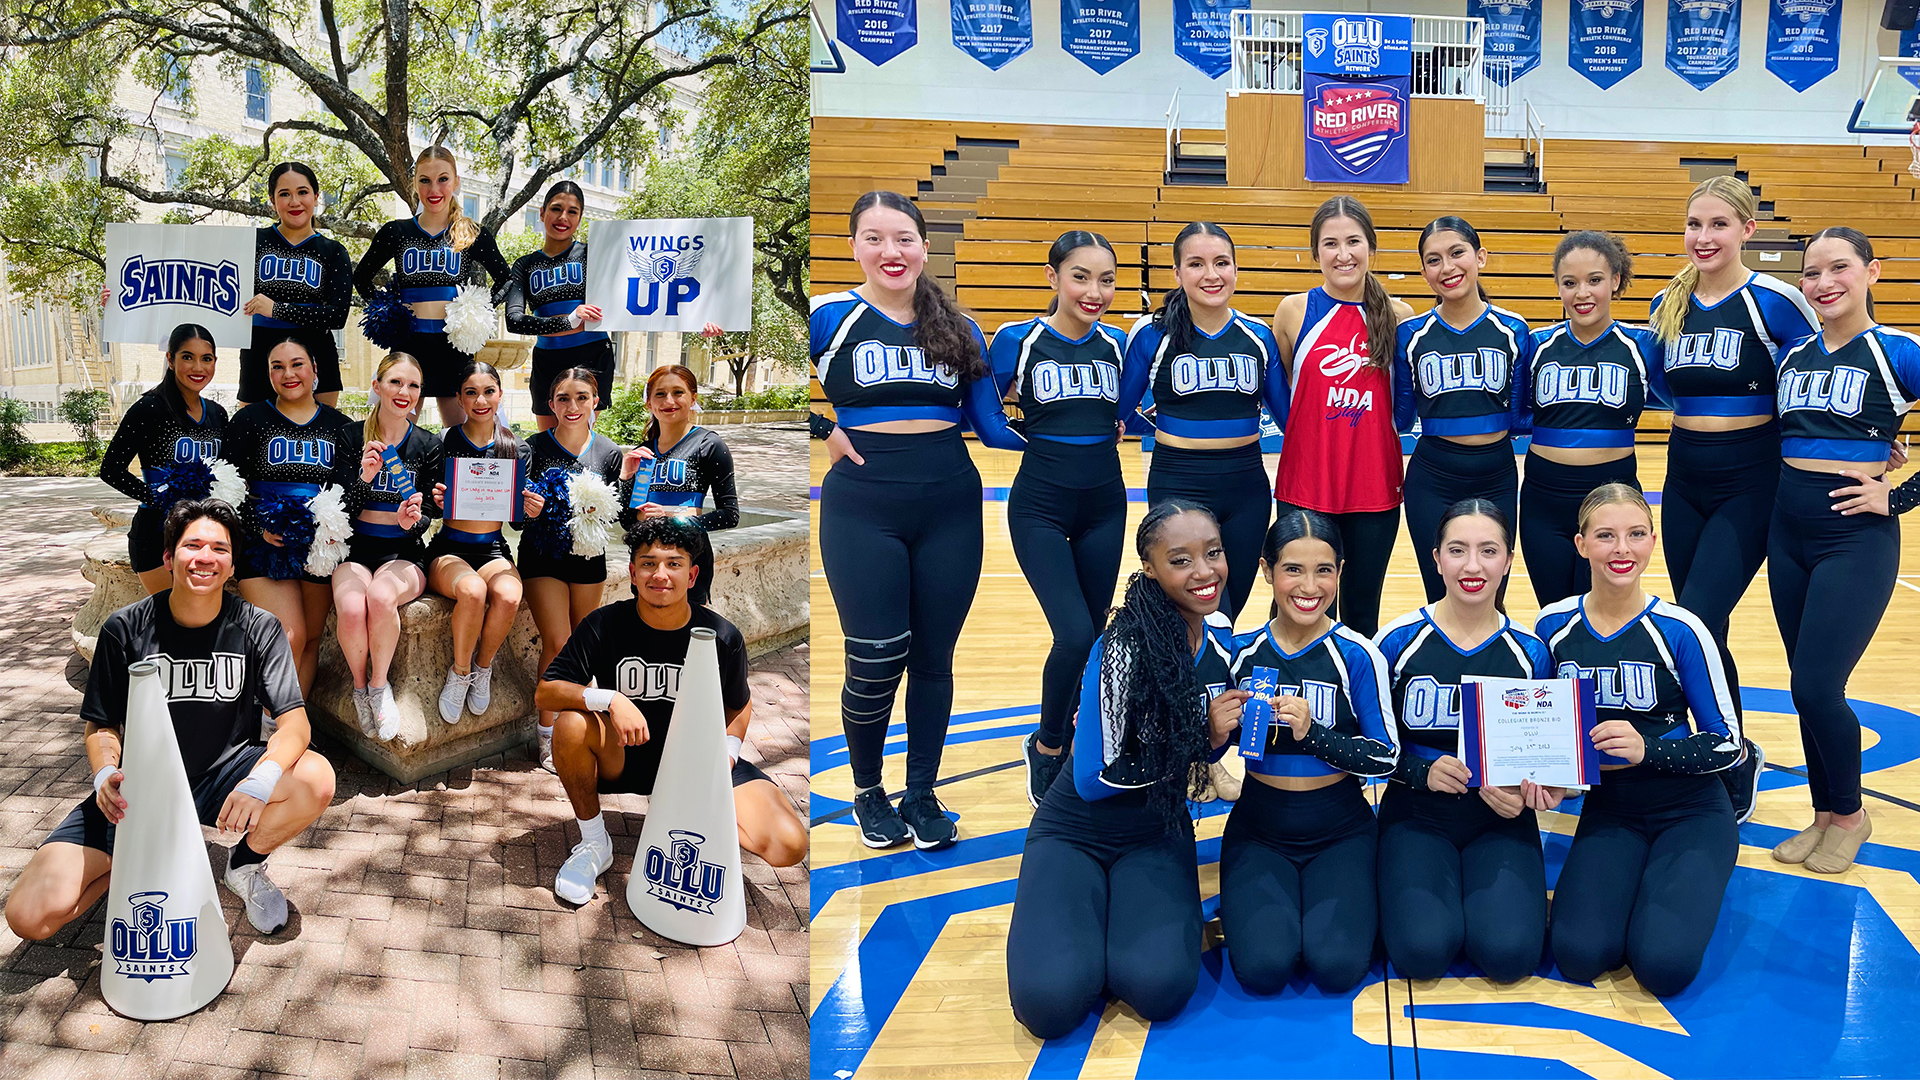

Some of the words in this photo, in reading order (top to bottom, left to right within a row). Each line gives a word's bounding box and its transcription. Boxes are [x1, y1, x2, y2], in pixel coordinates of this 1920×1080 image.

[874, 0, 898, 9] RIVER
[969, 4, 986, 12] RED
[988, 4, 1013, 14] RIVER
[872, 8, 904, 18] CONFERENCE
[987, 13, 1020, 22] CONFERENCE
[1080, 8, 1095, 16] RED
[1098, 8, 1122, 18] RIVER
[1210, 12, 1231, 20] RIVE
[864, 20, 888, 29] 2016
[1096, 17, 1128, 27] CONFERENCE
[1503, 23, 1525, 32] RIVER
[980, 25, 1003, 33] 2017
[1089, 29, 1112, 38] 2017
[1332, 17, 1383, 49] OLLU
[1604, 26, 1627, 35] RIVER
[1702, 27, 1724, 36] RIVER
[1802, 28, 1825, 36] RIVER
[1501, 32, 1530, 40] CONFERENCE
[1602, 35, 1632, 43] CONFERENCE
[1700, 36, 1728, 44] CONFERENCE
[1493, 43, 1515, 52] 2018
[1594, 46, 1616, 55] 2018
[1677, 47, 1698, 55] 2017
[1706, 47, 1728, 56] 2018
[1792, 45, 1814, 53] 2018
[1334, 47, 1380, 68] SAINTS
[1315, 110, 1347, 128] RED
[1351, 103, 1398, 124] RIVER
[1351, 119, 1398, 131] CONFERENCE
[629, 235, 704, 251] WINGS
[402, 246, 461, 278] OLLU
[258, 254, 323, 289] OLLU
[529, 262, 584, 296] OLLU
[118, 254, 240, 317] SAINTS
[626, 276, 701, 316] UP
[1172, 352, 1259, 396] OLLU
[1418, 348, 1508, 398] OLLU
[1032, 358, 1120, 405] OLLU
[1536, 361, 1630, 409] OLLU
[1326, 386, 1372, 412] NDA
[1326, 400, 1369, 428] Staff
[268, 436, 336, 470] OLLU
[650, 458, 688, 487] LU
[616, 656, 686, 702] OLL
[1253, 691, 1270, 700] NDA
[1250, 705, 1261, 747] SUPERIOR
[643, 845, 726, 904] OLLU
[657, 888, 703, 908] SAINTS
[110, 917, 198, 962] OLLU
[126, 964, 175, 973] SAINTS
